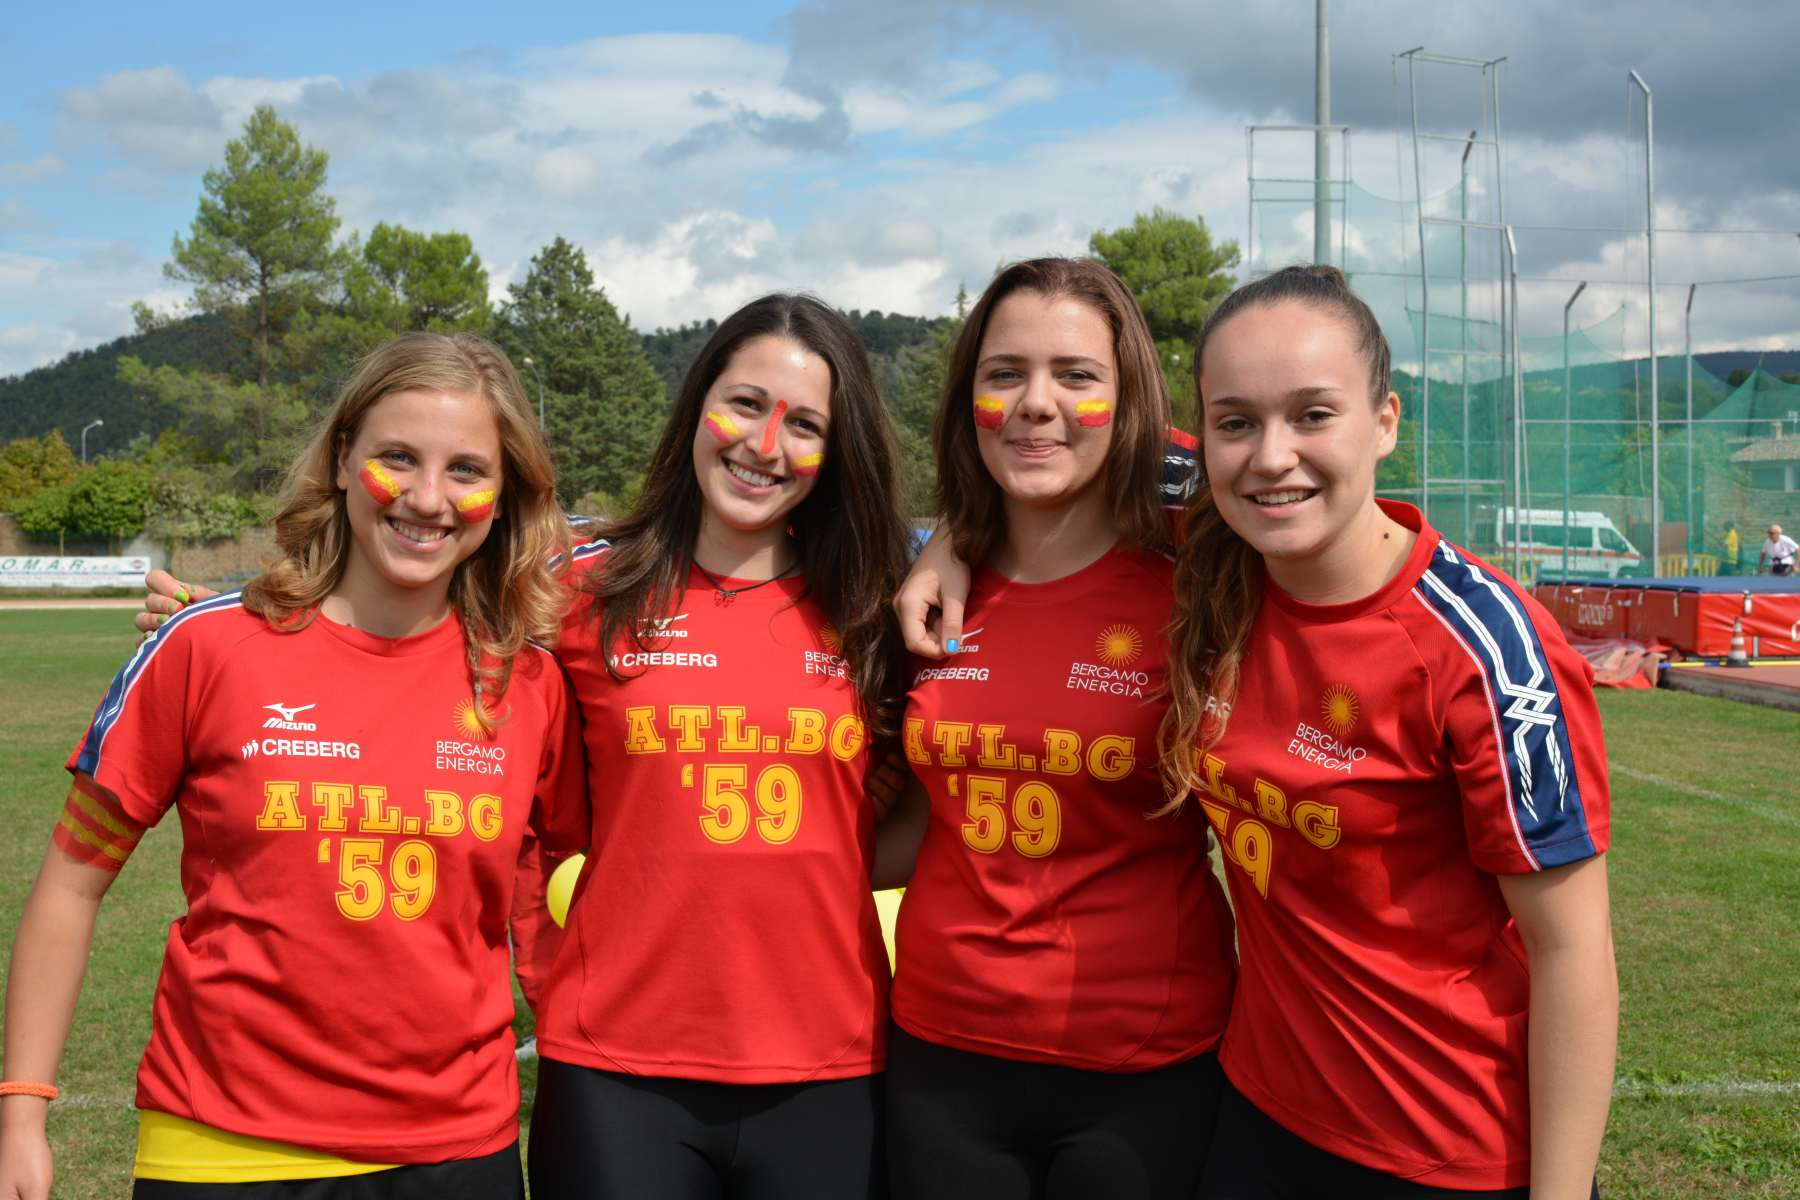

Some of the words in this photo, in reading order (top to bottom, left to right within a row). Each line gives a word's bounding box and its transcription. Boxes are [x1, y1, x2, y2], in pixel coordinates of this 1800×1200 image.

[621, 652, 718, 668] CREBERG
[804, 650, 851, 669] BERGA
[921, 667, 991, 682] CREBERG
[1071, 662, 1149, 687] BERGAMO
[1066, 676, 1143, 700] ENERGIA
[624, 705, 865, 762] ATL.BG
[1295, 721, 1367, 762] BERGAMO
[261, 738, 361, 760] CREBERG
[435, 740, 506, 761] BERGAMO
[905, 717, 1137, 782] ATL.BG
[1287, 738, 1353, 776] ENERGIA
[435, 756, 505, 777] ENERGIA
[256, 780, 504, 842] ATL.BG
